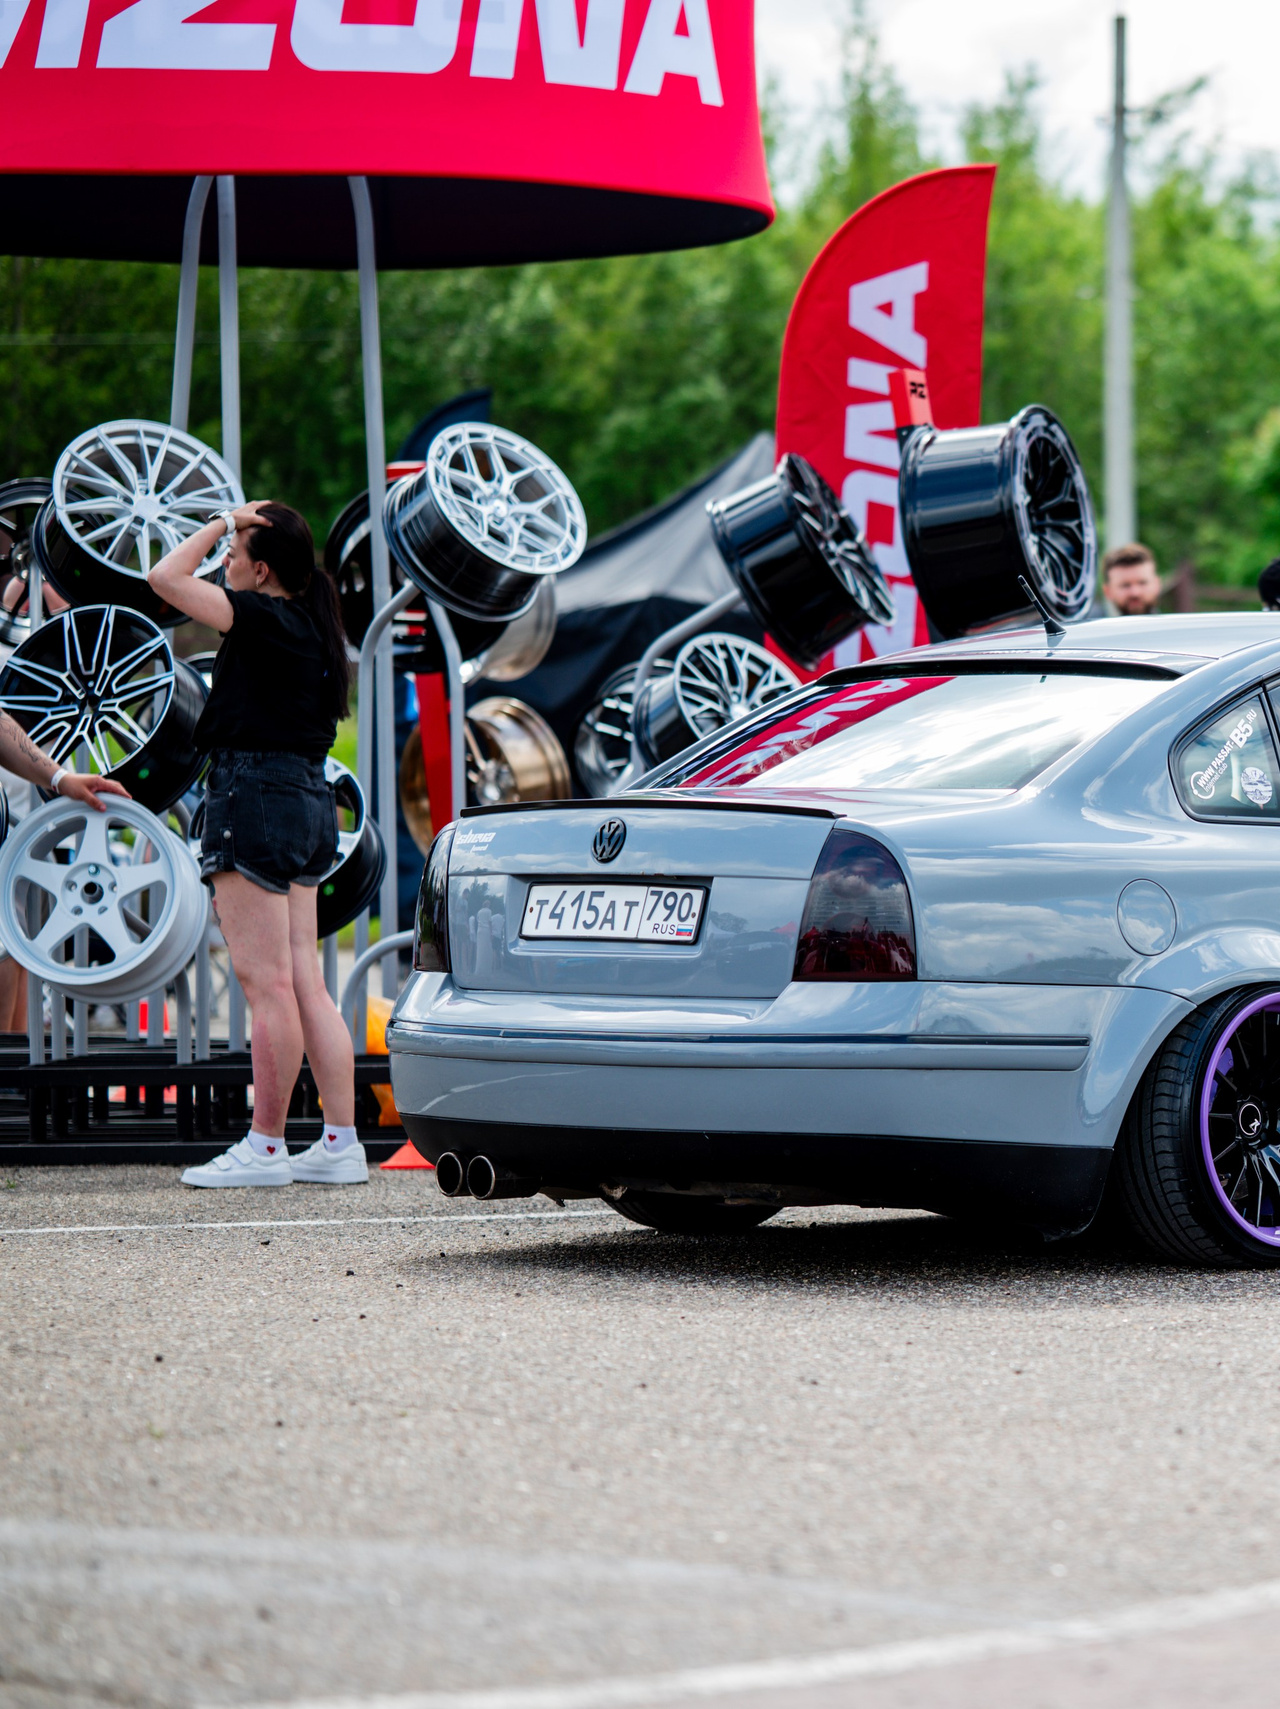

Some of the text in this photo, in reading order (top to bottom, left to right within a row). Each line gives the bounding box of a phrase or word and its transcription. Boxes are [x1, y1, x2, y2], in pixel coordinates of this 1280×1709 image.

[535, 890, 694, 931] T415AT 790
[652, 923, 676, 935] RUS
